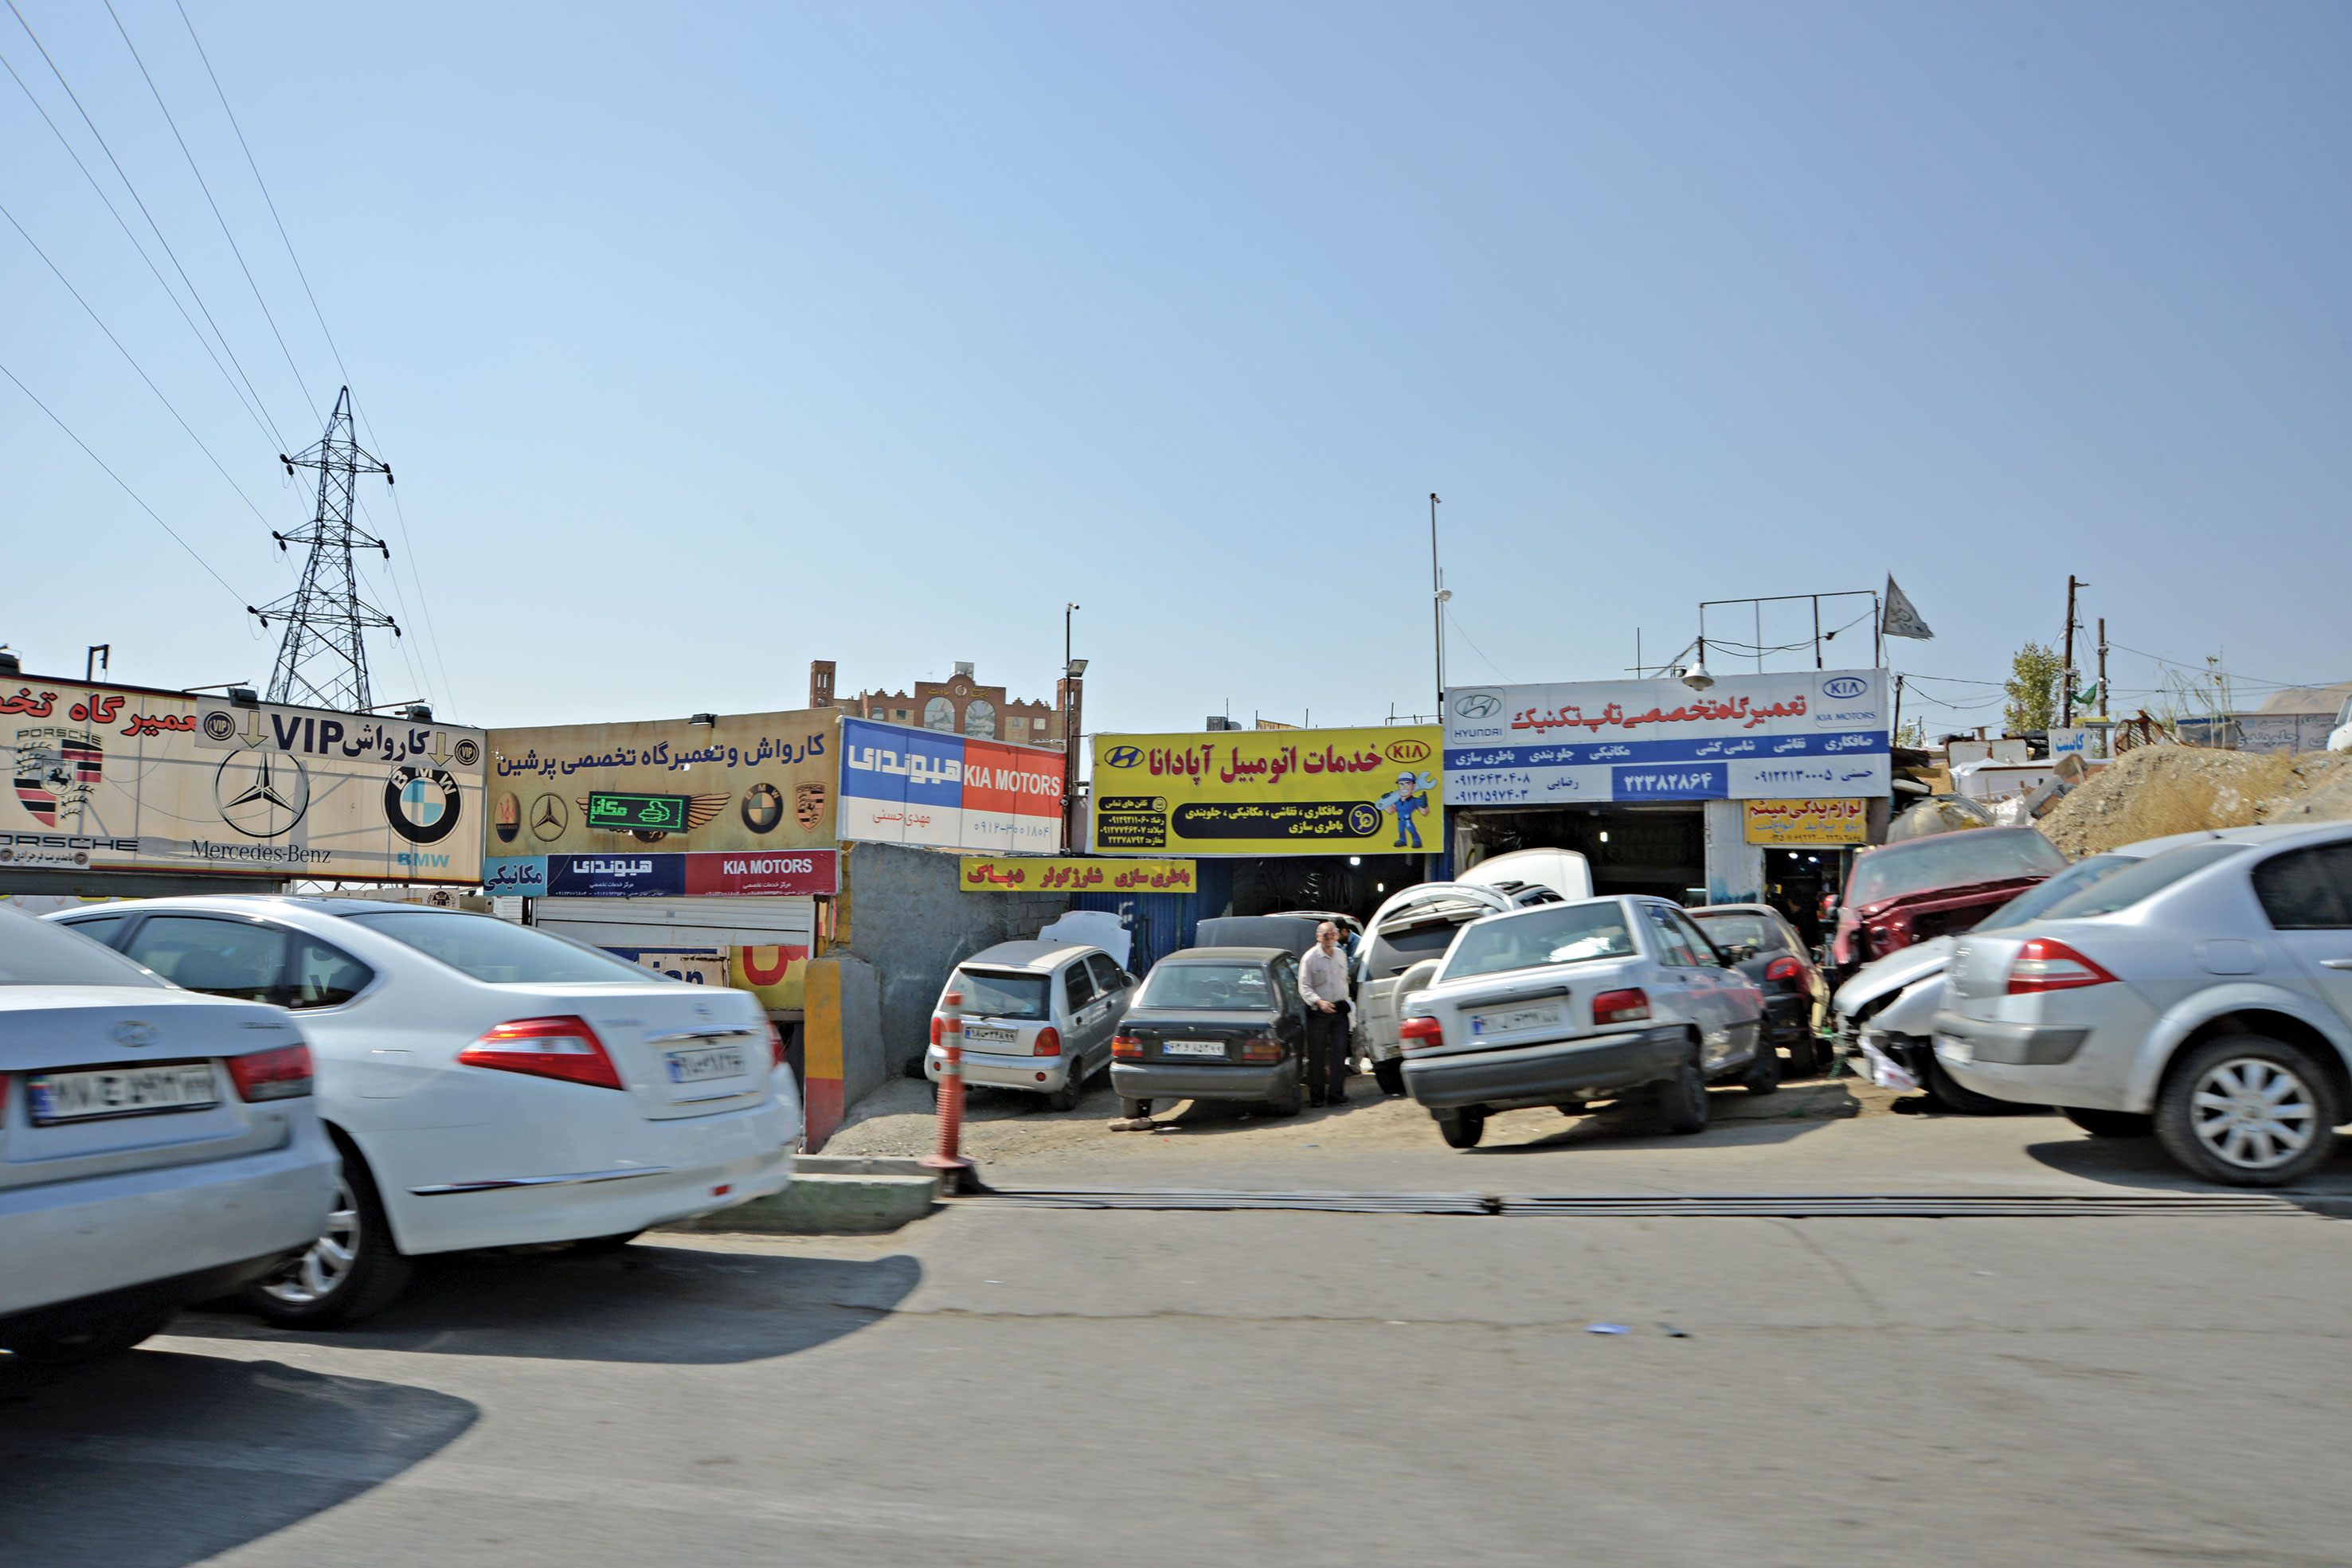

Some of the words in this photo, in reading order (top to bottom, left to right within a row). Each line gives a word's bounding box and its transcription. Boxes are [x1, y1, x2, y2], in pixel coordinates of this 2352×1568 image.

[1830, 681, 1861, 694] KIA
[1622, 698, 1718, 729] تخصصی
[1718, 694, 1807, 729] تعمیرگاه
[1834, 711, 1877, 721] MOTORS
[213, 719, 227, 733] VIP
[270, 714, 344, 755] VIP
[1454, 728, 1503, 738] HYUNDAI
[16, 727, 103, 746] PORSCHE
[342, 723, 431, 762] کارواش
[1773, 737, 1807, 753] نقاشی
[1824, 734, 1874, 752] صافکاری
[461, 746, 474, 758] VIP
[744, 733, 825, 767] کارواش
[1392, 745, 1423, 758] KIA
[1589, 745, 1631, 761] مکانیکی
[1695, 741, 1723, 757] کشی
[1723, 739, 1755, 756] شاسی
[497, 749, 557, 780] پرشین
[561, 746, 637, 776] تخصصی
[847, 745, 961, 784] هیوندای
[1148, 743, 1216, 786] آپادانا
[1219, 745, 1297, 784] اتومبیل
[1302, 742, 1384, 775] خدمات
[1455, 752, 1482, 766] سازی
[1483, 749, 1515, 765] باطری
[963, 764, 992, 789] KIA
[995, 768, 1061, 797] MOTORS
[1546, 777, 1579, 791] رضایی
[872, 809, 904, 824] حسنی
[1184, 807, 1222, 820] جلوبندی
[1749, 800, 1789, 819] میثم
[1789, 800, 1827, 819] یدکی
[1829, 800, 1862, 819] لوازم
[904, 812, 931, 827] مهدی
[1288, 821, 1313, 834] سازی
[1313, 821, 1344, 834] باطری
[189, 839, 331, 864] Mercedes-Benz
[397, 851, 450, 868] BMW
[573, 860, 652, 878] هیوندای
[723, 860, 749, 875] KIA
[750, 858, 813, 874] MOTORS
[483, 864, 543, 892] مکانیکی
[1114, 868, 1149, 887] سازی
[1150, 867, 1191, 887] باطری
